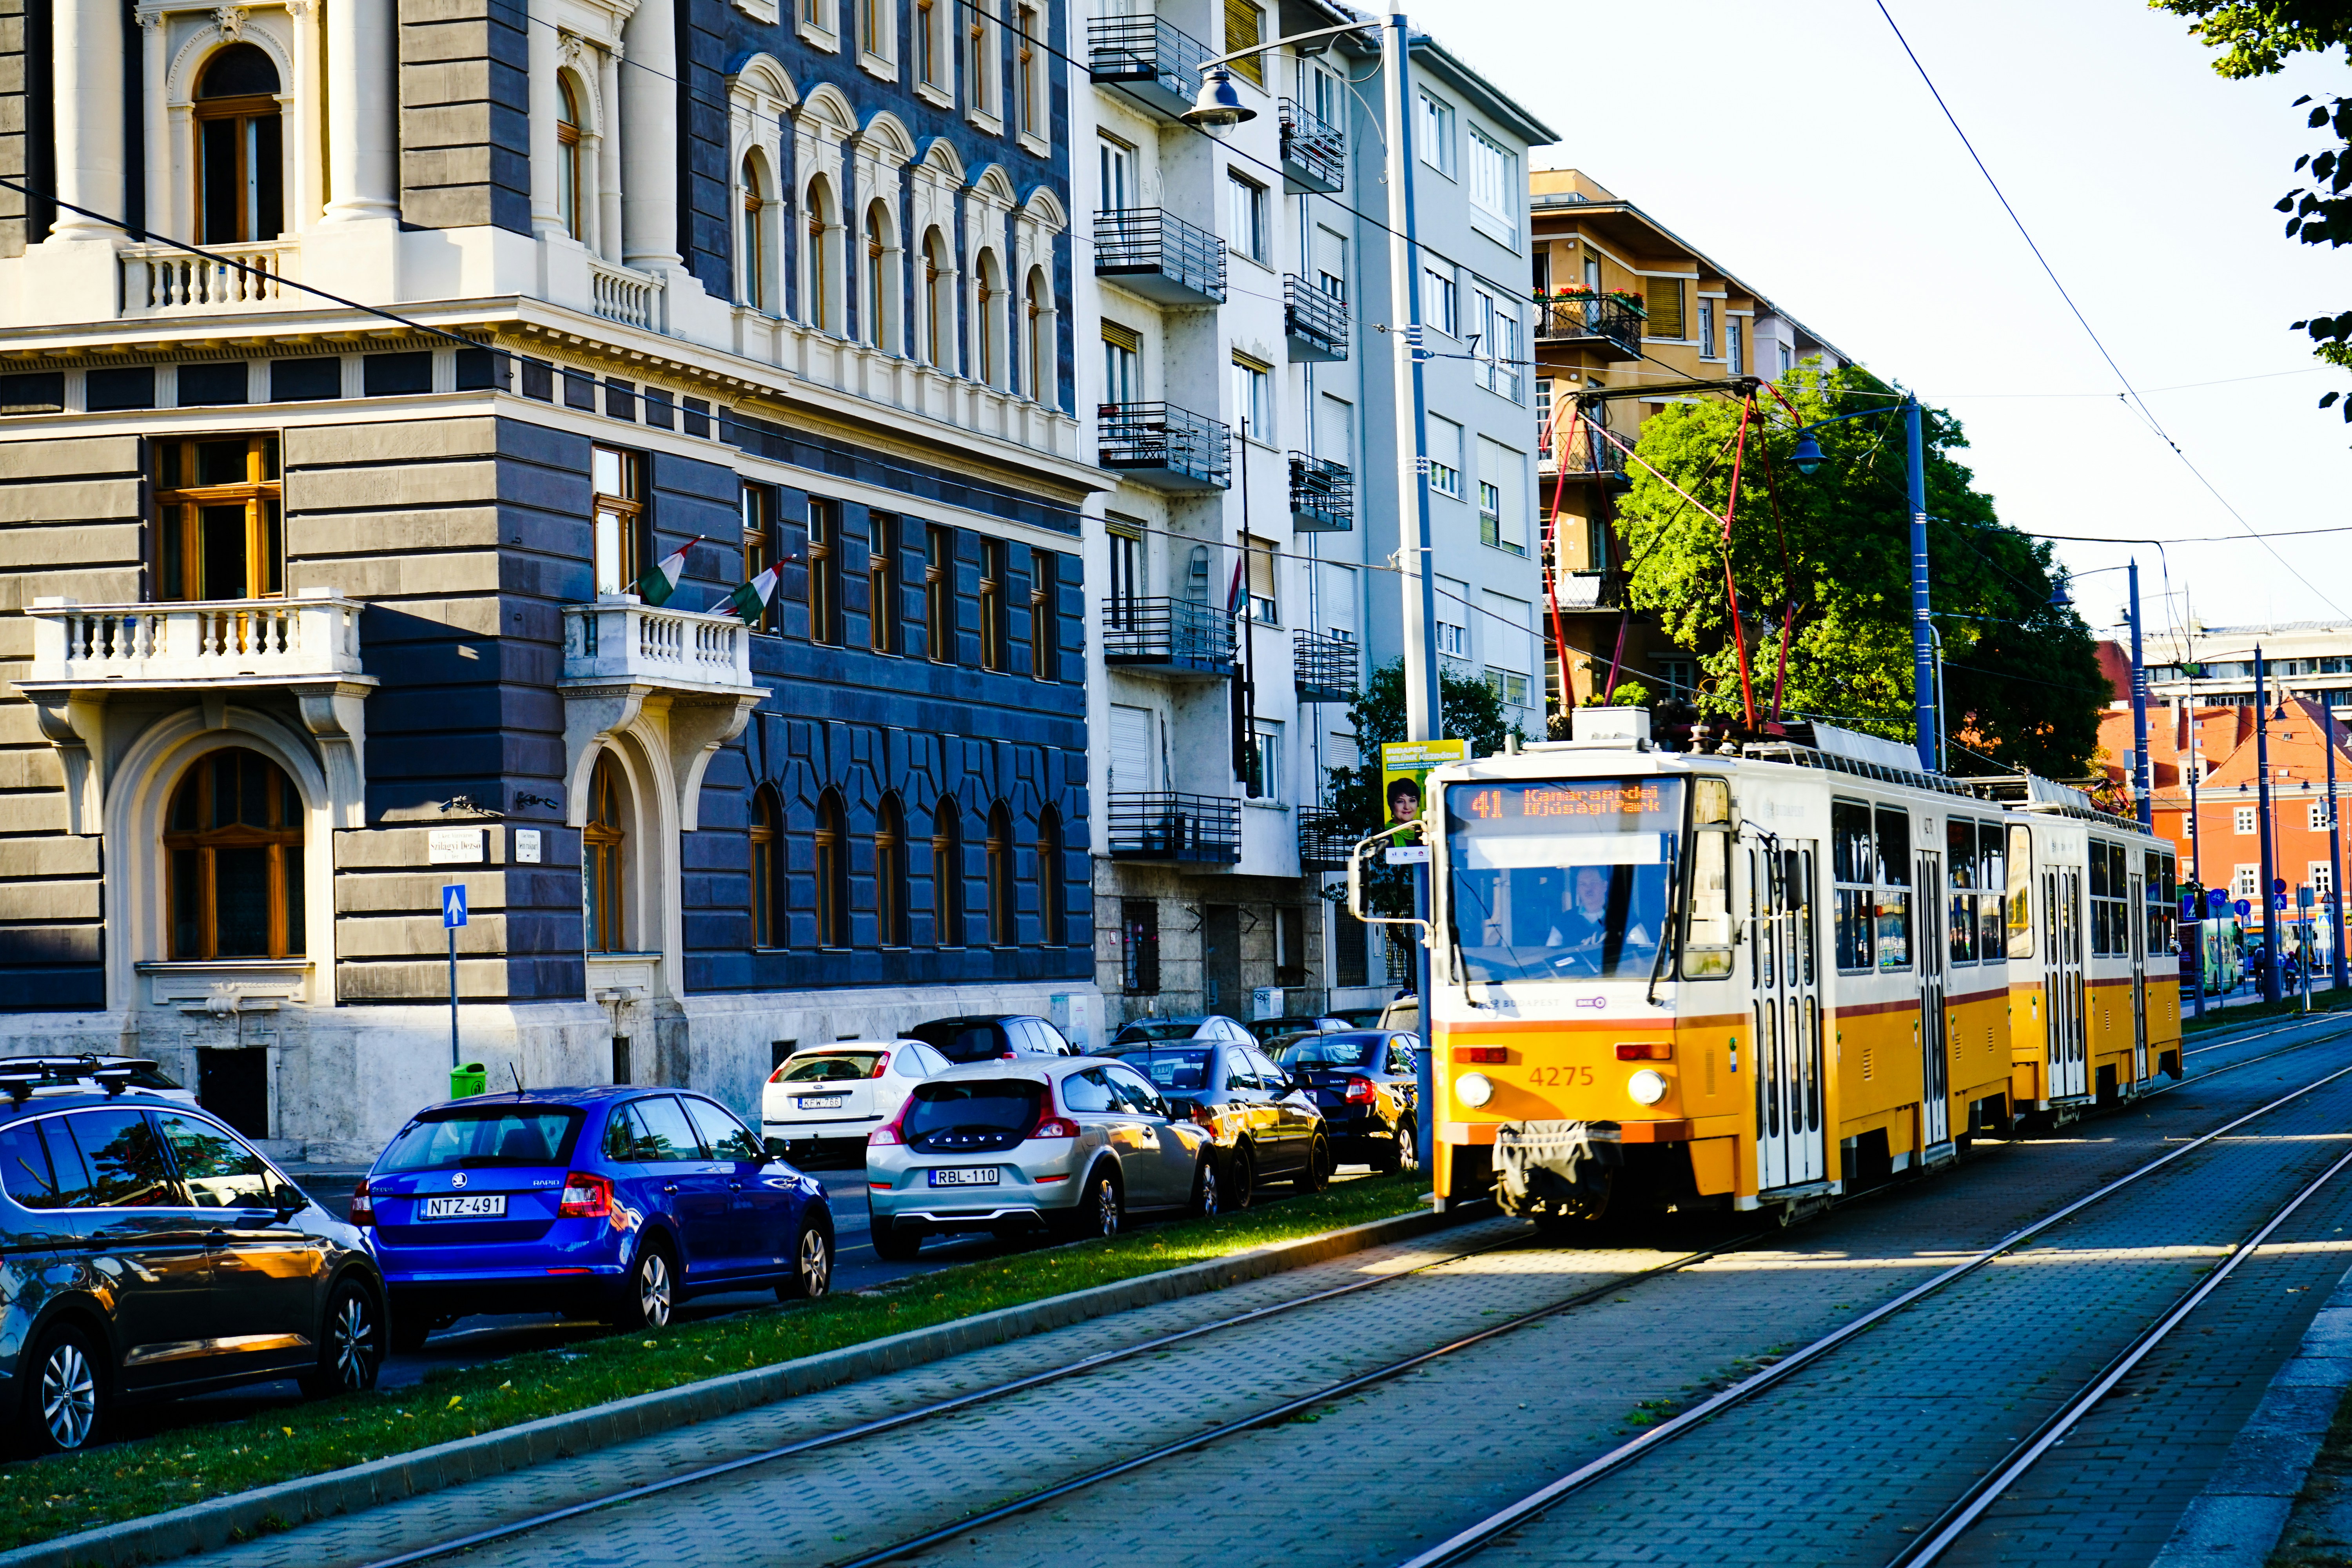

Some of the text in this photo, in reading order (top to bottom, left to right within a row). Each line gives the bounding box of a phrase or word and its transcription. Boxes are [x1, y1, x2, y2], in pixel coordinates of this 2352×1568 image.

[1386, 746, 1428, 754] BUDAPEST
[1386, 751, 1461, 762] VELÜNK KEZDŐDIK
[1472, 786, 1657, 818] 41 Kamaraerdei
[1610, 799, 1660, 813] Park
[431, 840, 481, 853] Szilágyi Dezső
[1502, 999, 1560, 1007] BUDAPEST
[1530, 1066, 1593, 1086] 4275
[804, 1098, 839, 1106] KFW-766
[939, 1170, 995, 1183] RBL-110
[431, 1198, 499, 1214] NTZ-491
